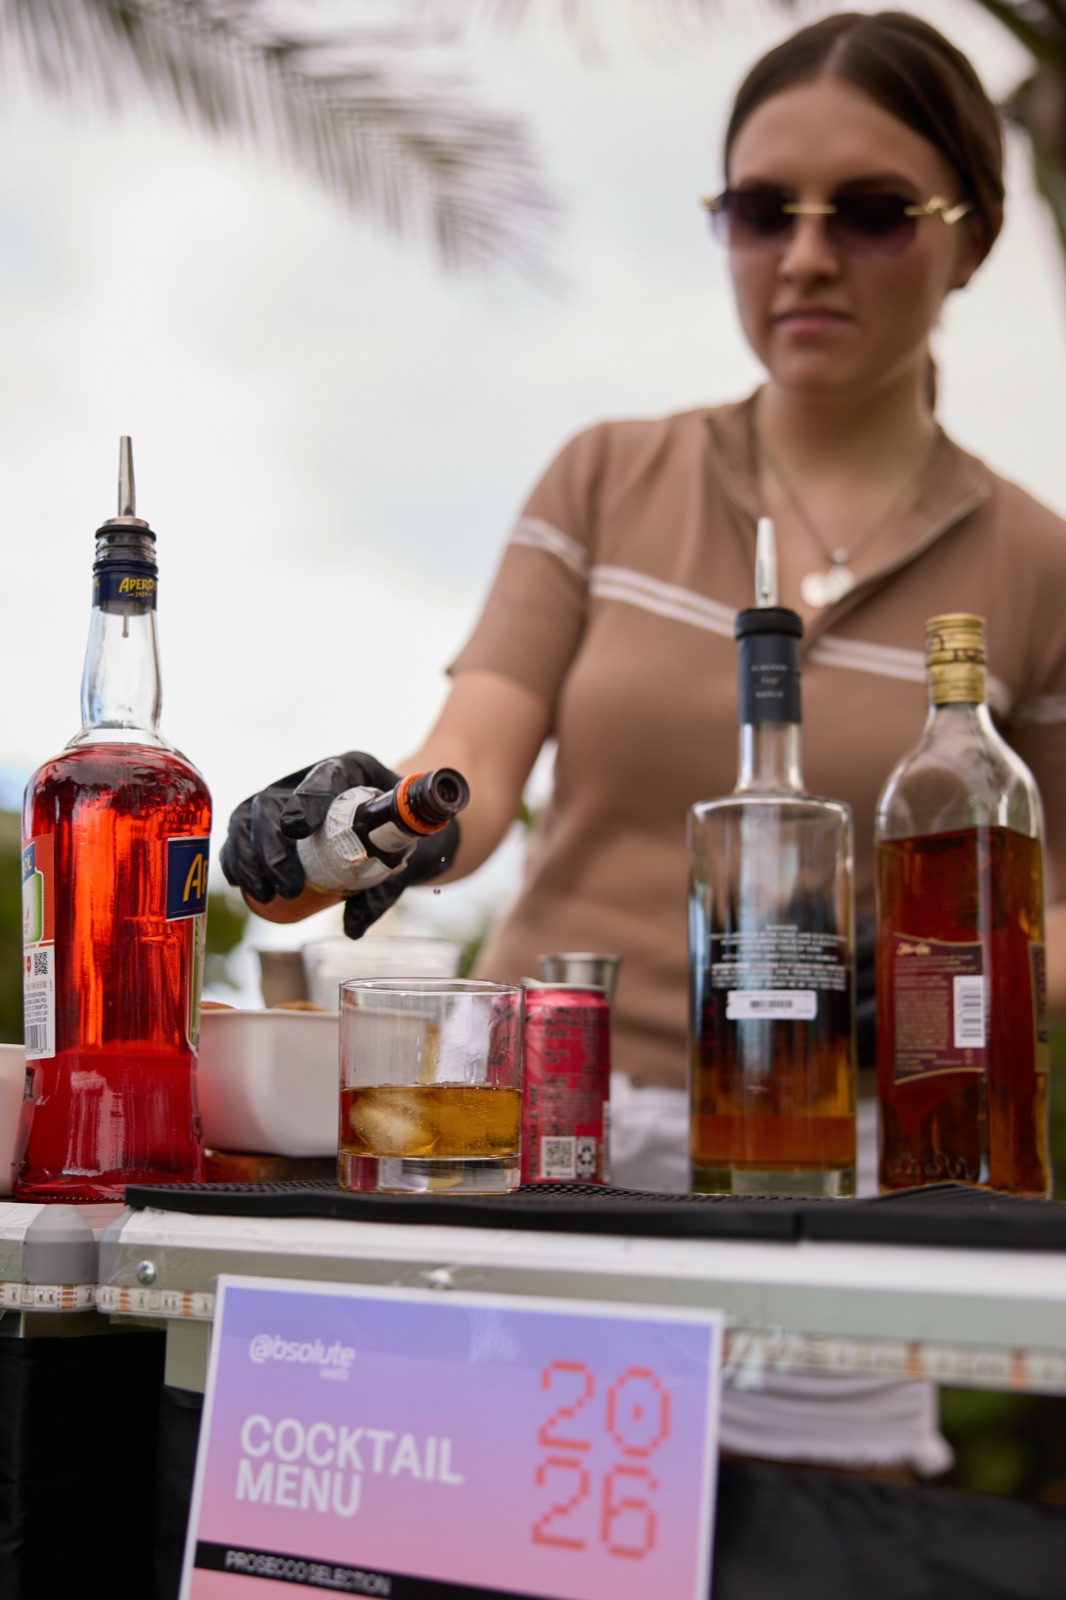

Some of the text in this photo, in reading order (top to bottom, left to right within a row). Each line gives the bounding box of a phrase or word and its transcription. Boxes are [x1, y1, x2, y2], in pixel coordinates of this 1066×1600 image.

[118, 577, 157, 593] APERO
[248, 1334, 356, 1368] @bsolute
[536, 1359, 671, 1458] 20
[240, 1414, 465, 1485] COCKTAIL
[235, 1457, 362, 1518] MENU
[531, 1454, 661, 1561] 26
[224, 1550, 392, 1597] PROSECCO SELECTION
